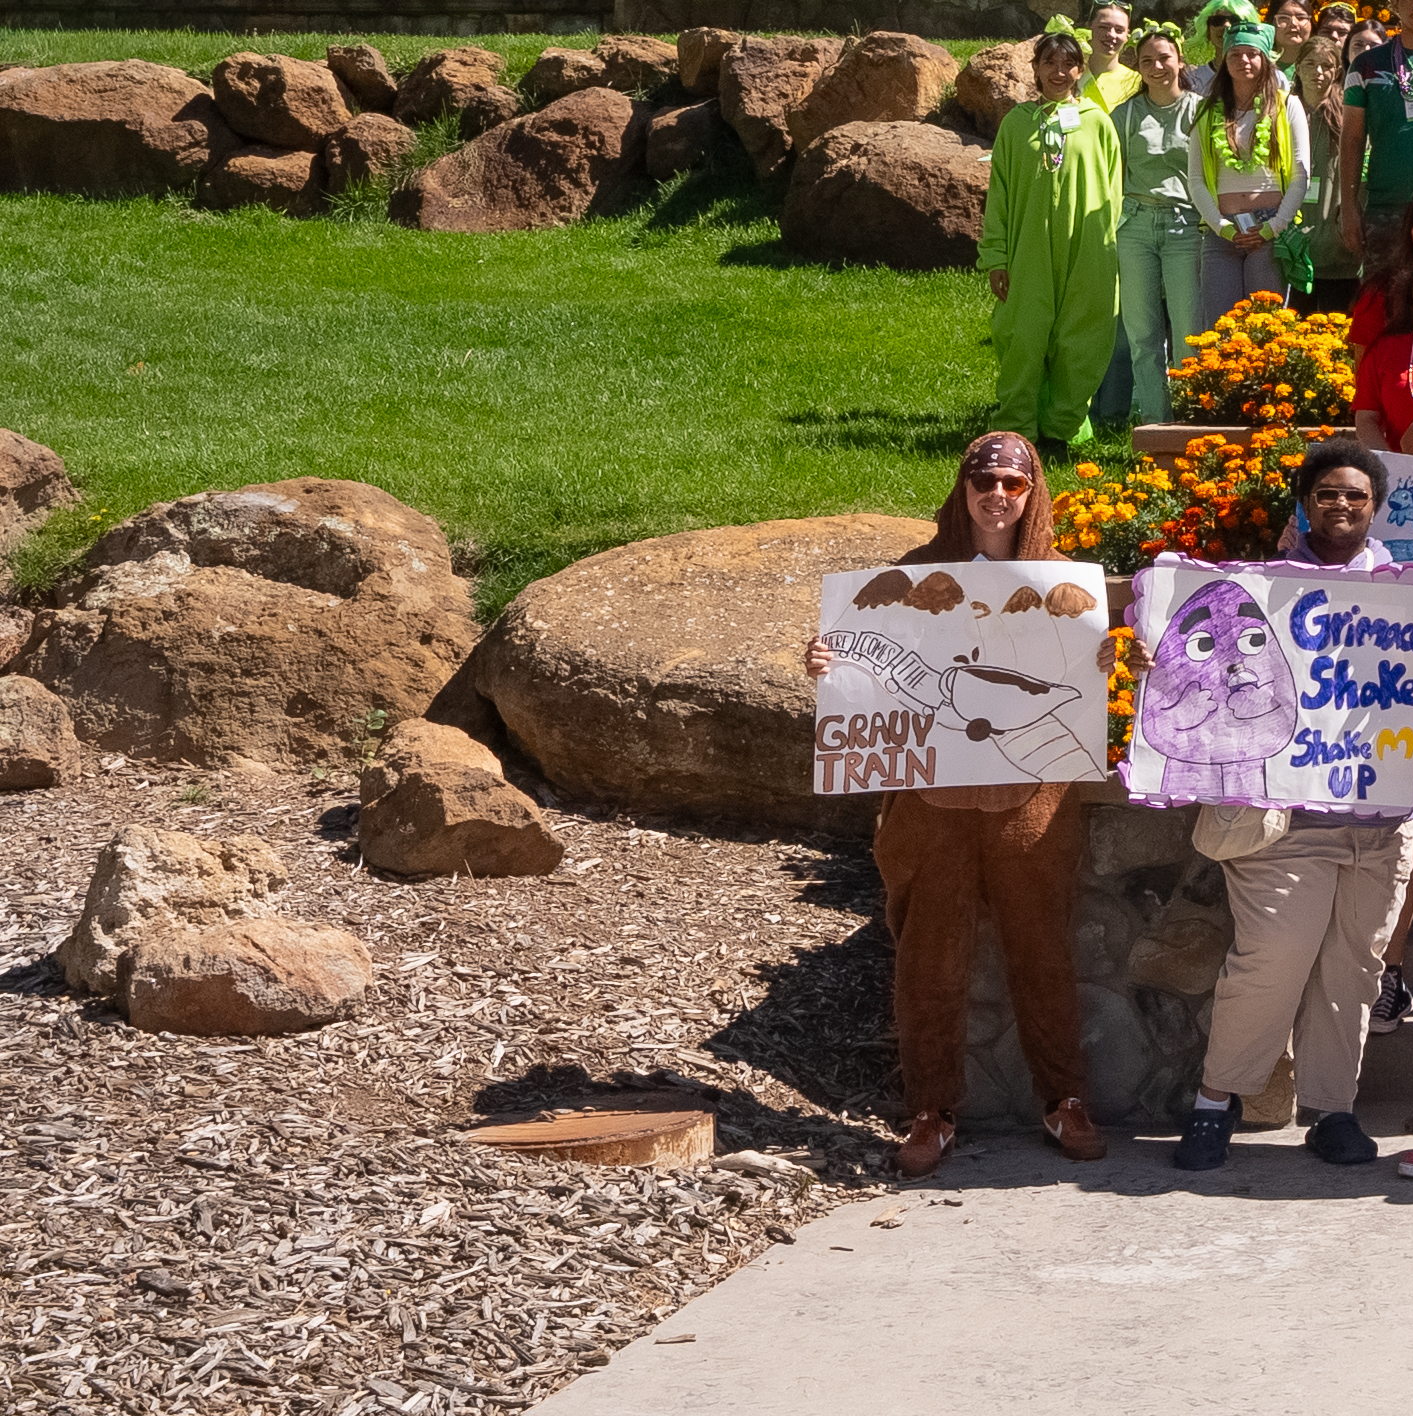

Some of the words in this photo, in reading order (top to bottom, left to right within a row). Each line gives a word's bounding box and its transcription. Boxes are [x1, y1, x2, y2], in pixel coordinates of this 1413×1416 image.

[859, 634, 896, 665] COMES
[898, 657, 933, 691] THE
[816, 746, 937, 794] TRAIN
